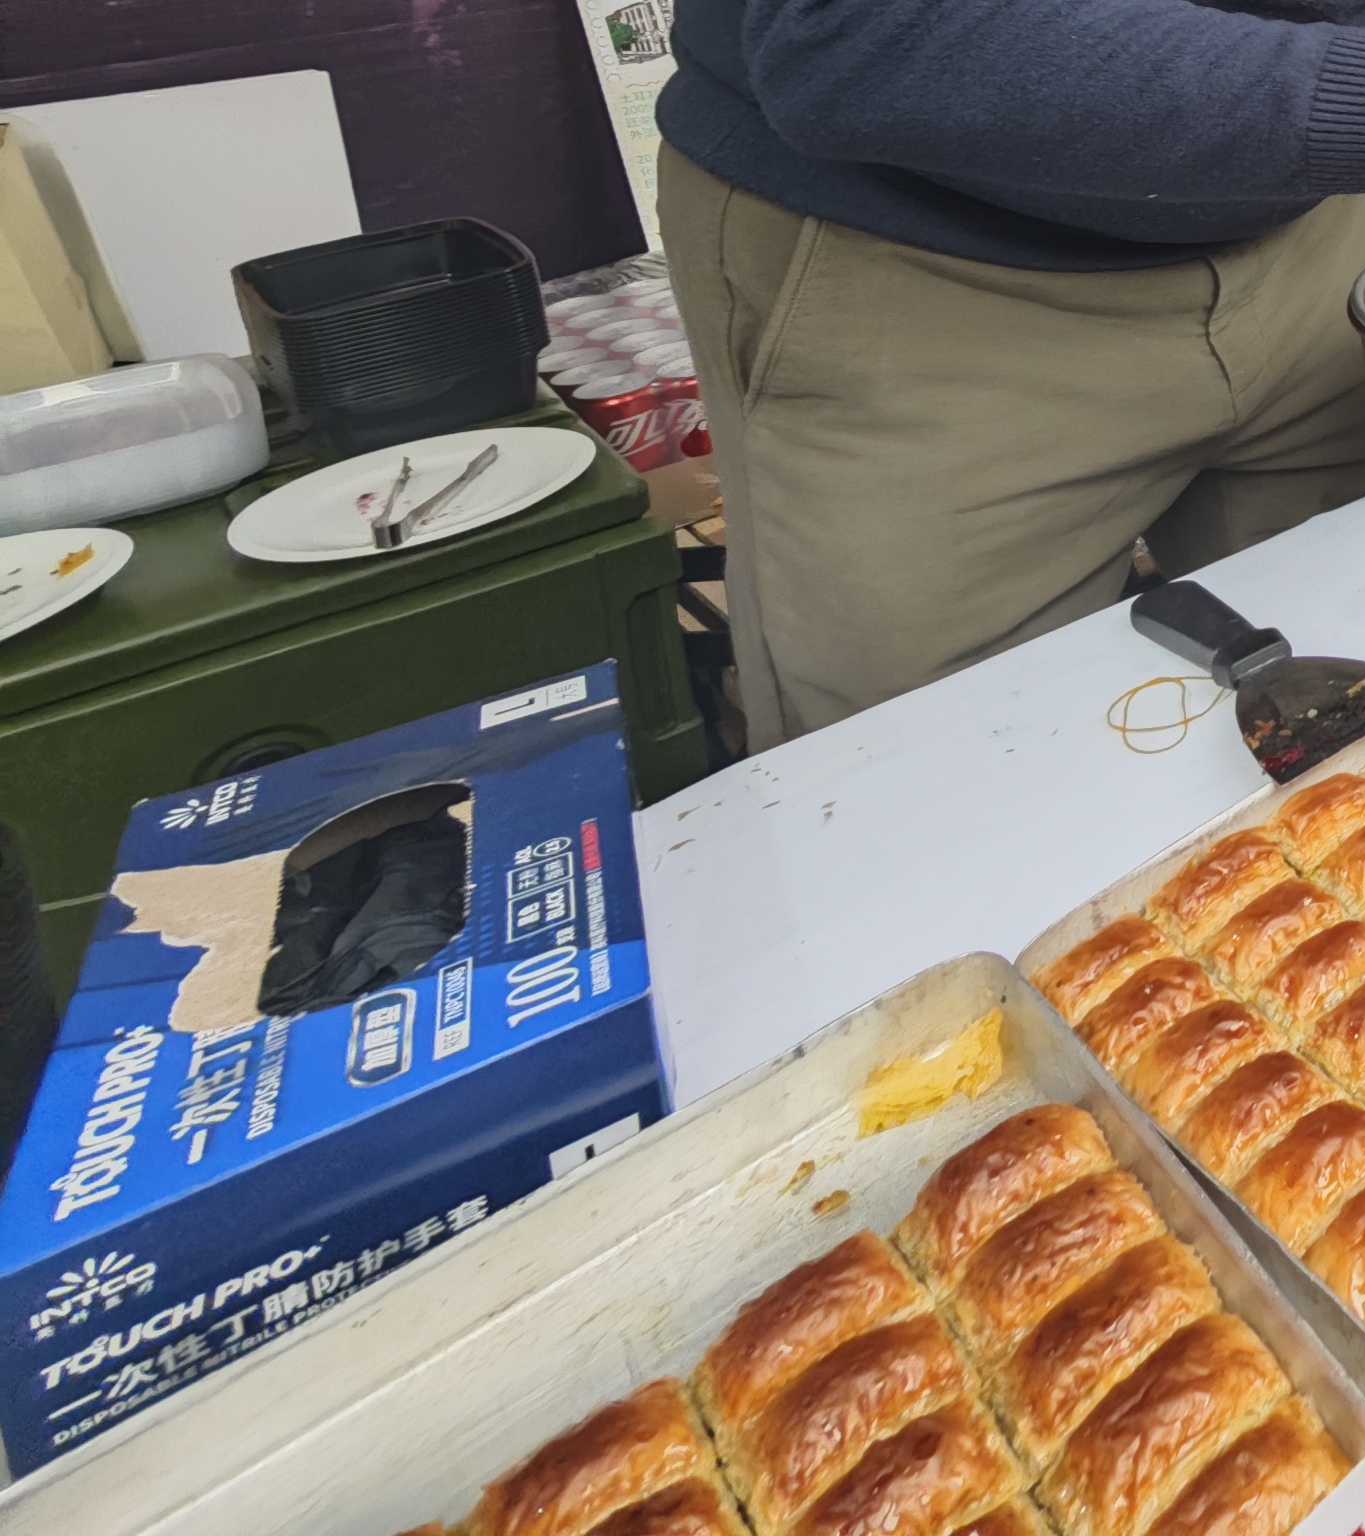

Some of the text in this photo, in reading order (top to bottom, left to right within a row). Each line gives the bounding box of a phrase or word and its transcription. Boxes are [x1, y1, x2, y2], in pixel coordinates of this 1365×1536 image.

[204, 781, 239, 827] INTCO
[545, 887, 566, 922] BLACK
[506, 945, 581, 1028] 100
[442, 1029, 464, 1050] REF
[246, 1049, 287, 1141] DISPOSABLE
[30, 1262, 157, 1331] INTCO
[48, 1194, 489, 1421] 一次性丁腈防护手套
[40, 1293, 207, 1390] TOUCH
[52, 1364, 198, 1446] DISPOSABLE
